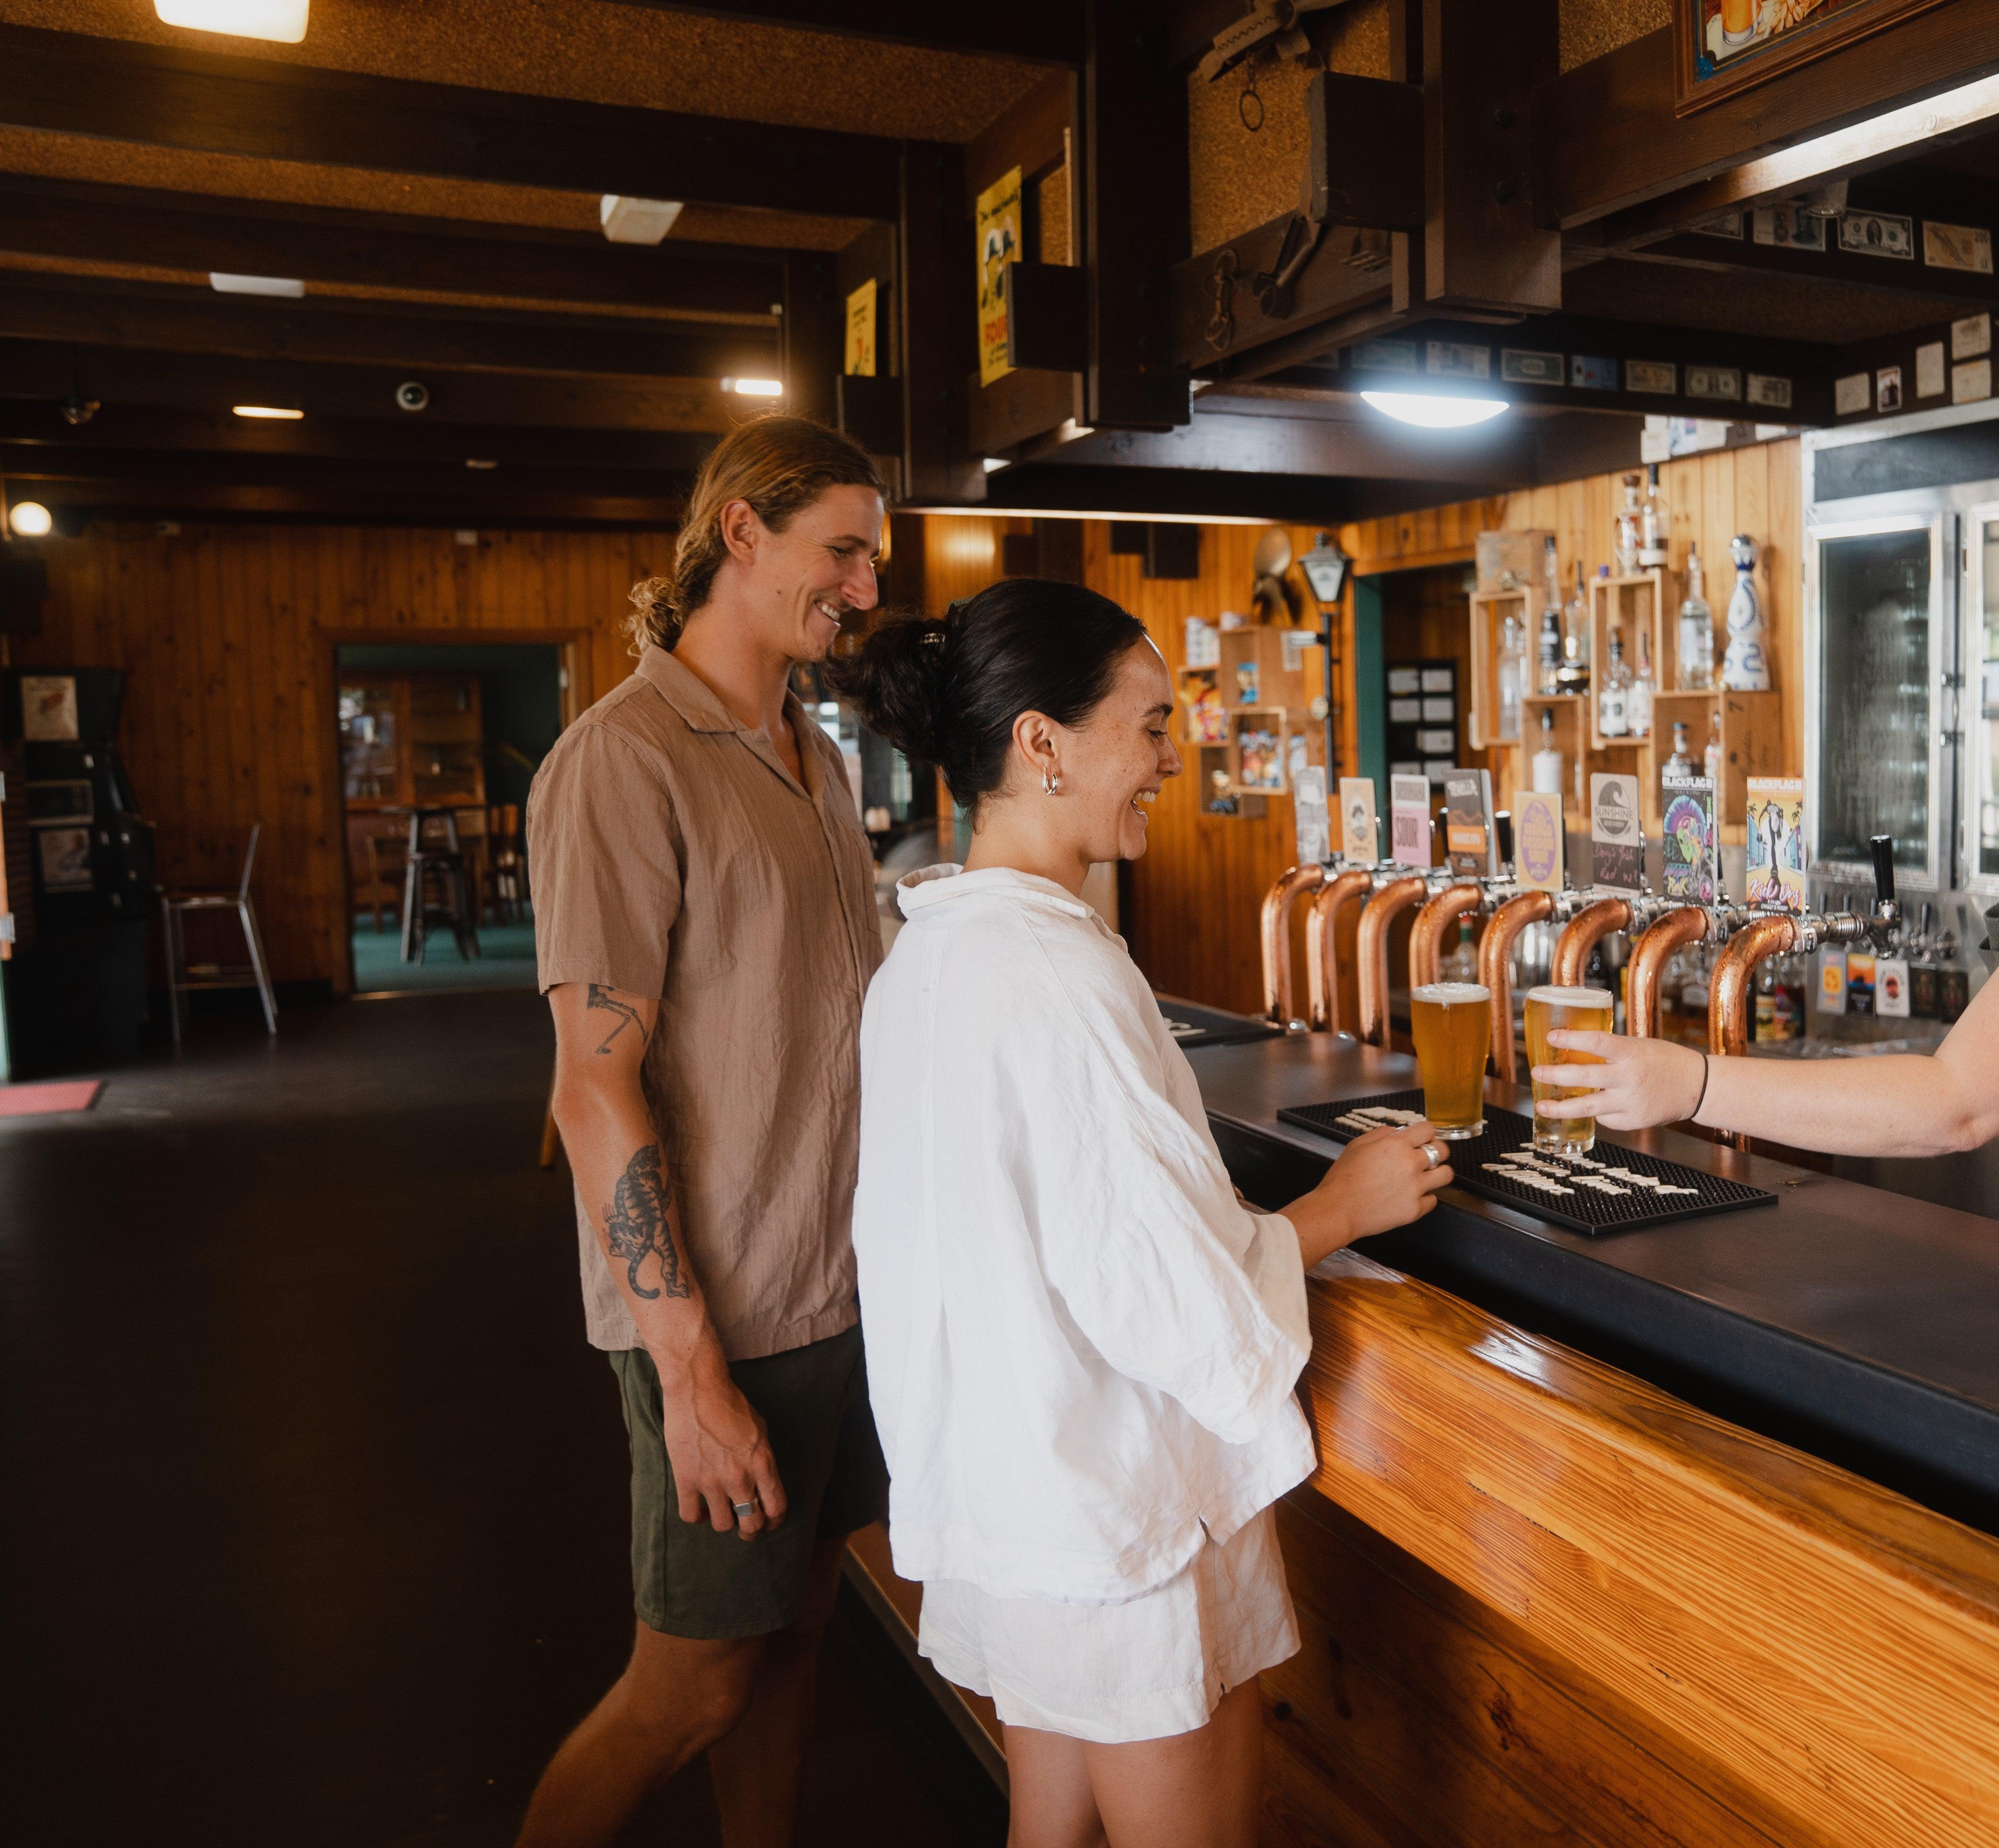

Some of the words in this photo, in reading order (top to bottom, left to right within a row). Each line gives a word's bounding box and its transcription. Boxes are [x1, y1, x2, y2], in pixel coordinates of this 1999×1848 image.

[1662, 777, 1705, 788] BLACKFLAG
[1748, 779, 1794, 790] BLACKFLAG
[1595, 806, 1633, 820] SUNSHINE
[1749, 878, 1779, 902] Kick
[1779, 881, 1801, 908] Ons
